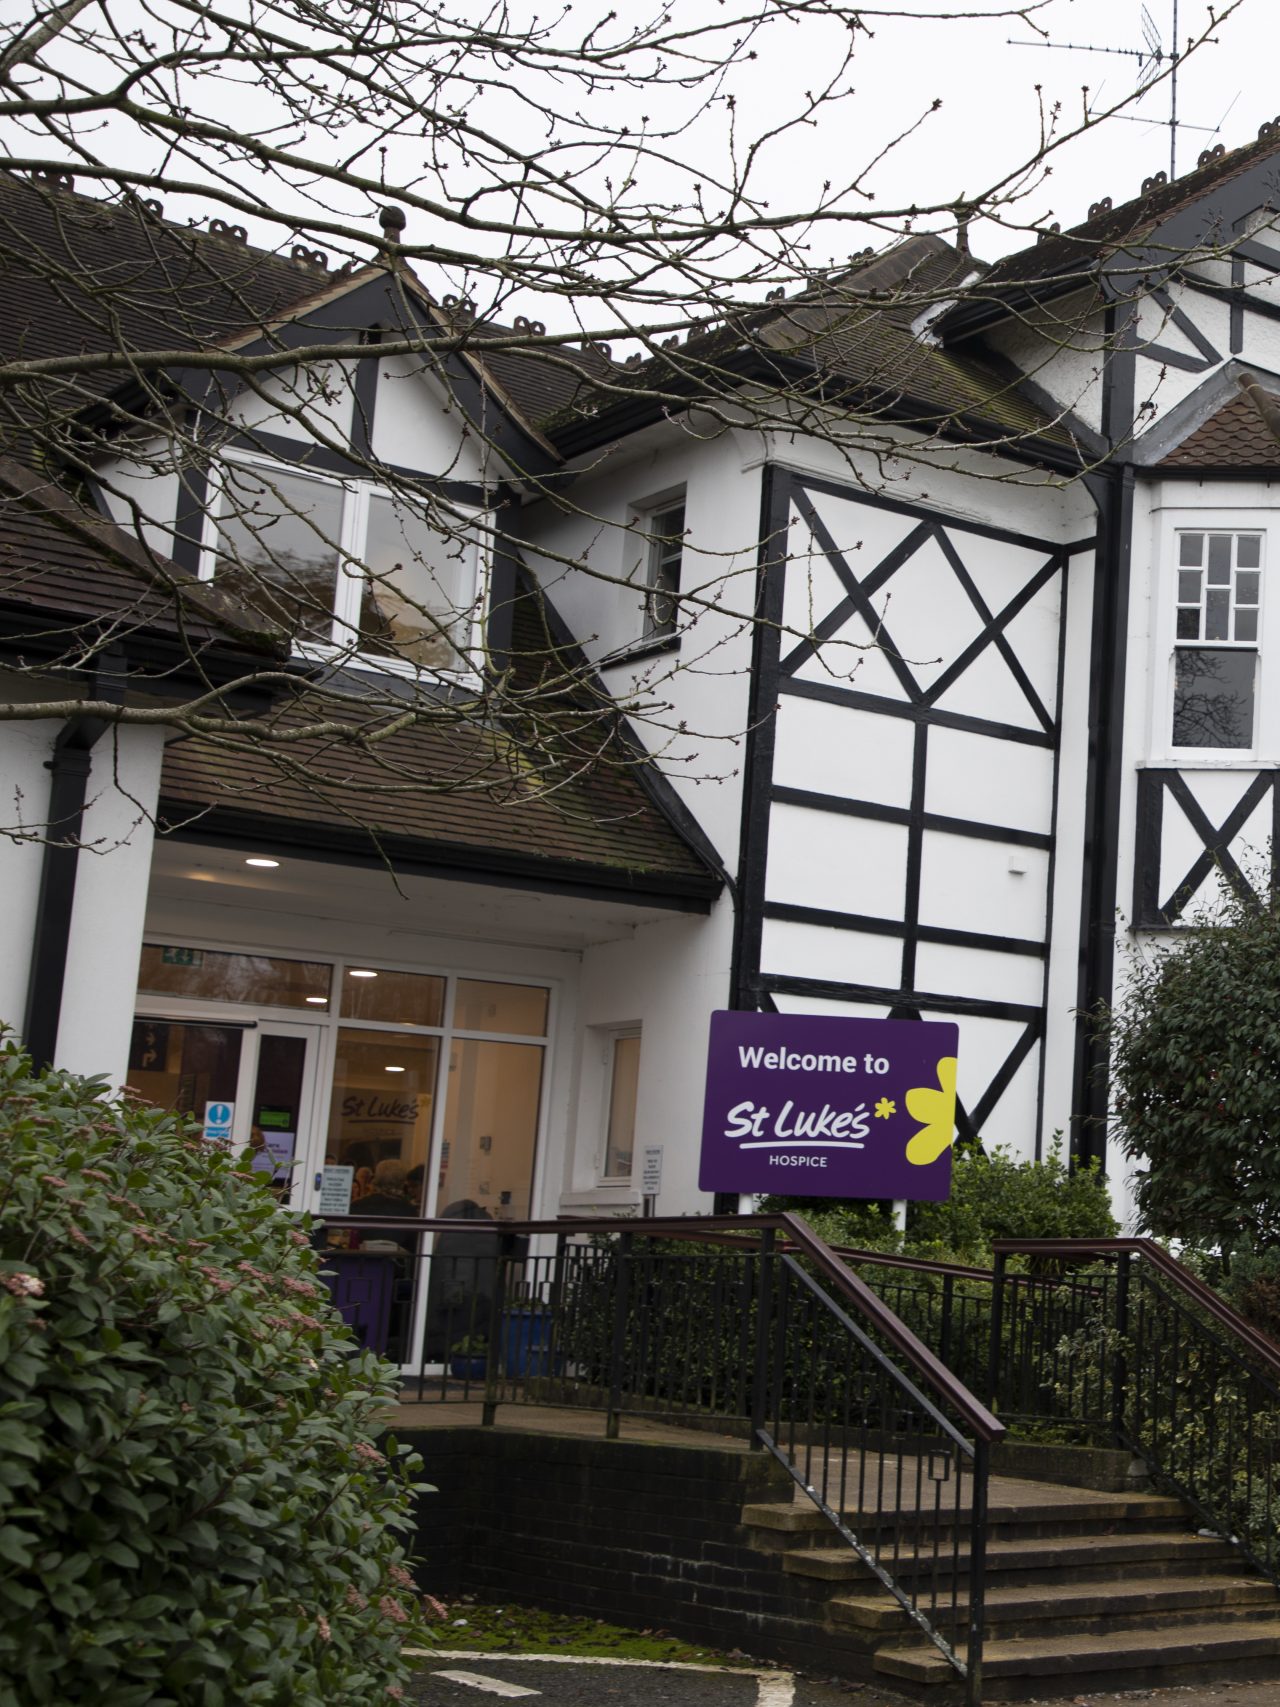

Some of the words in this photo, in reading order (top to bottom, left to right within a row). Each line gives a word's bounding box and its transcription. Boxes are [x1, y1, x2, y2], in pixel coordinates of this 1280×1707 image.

[738, 1046, 857, 1073] Welcome
[864, 1053, 890, 1075] to
[341, 1095, 365, 1117] St
[724, 1101, 770, 1138] St
[774, 1100, 870, 1139] Luke's
[769, 1155, 828, 1168] HOSPICE
